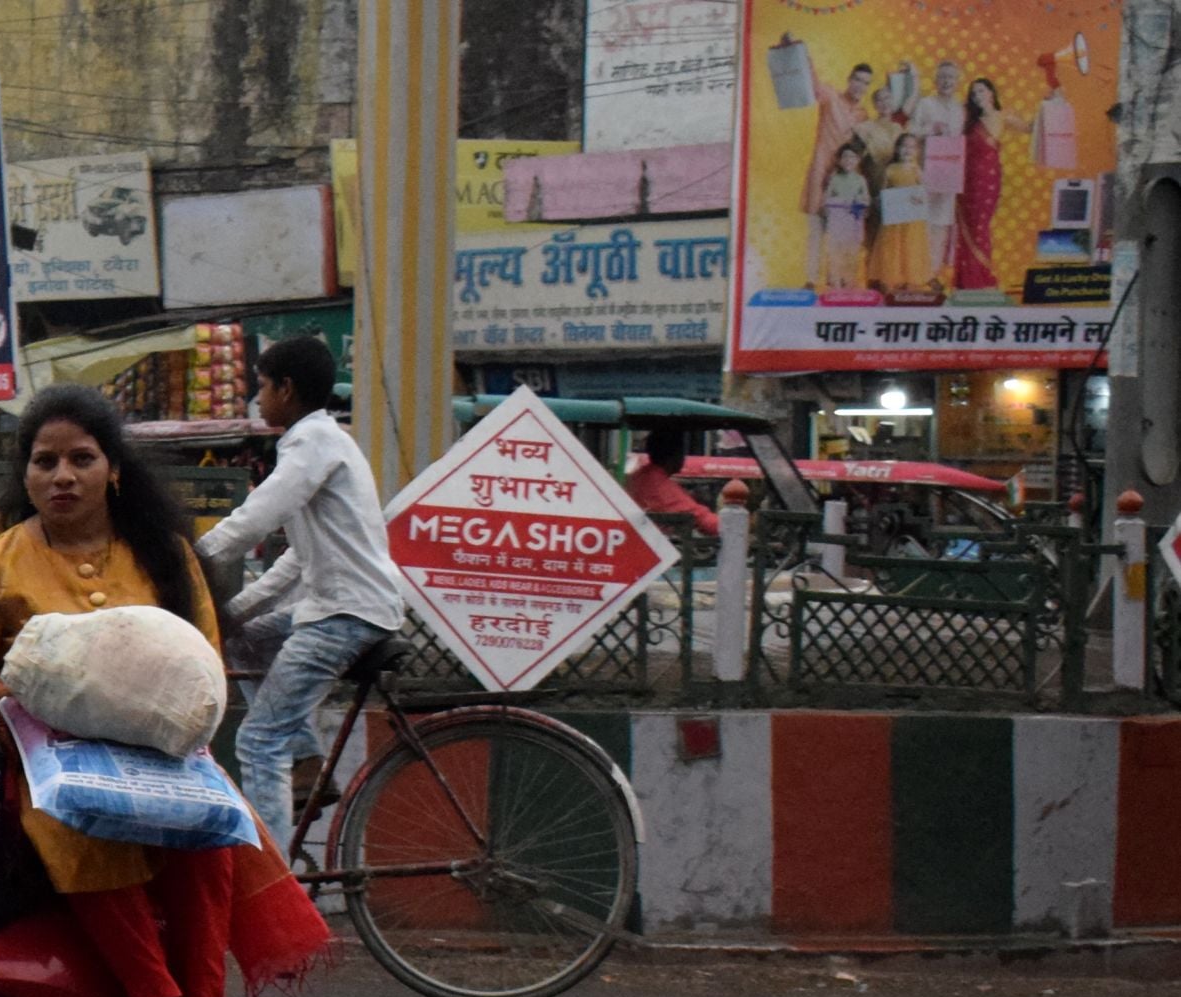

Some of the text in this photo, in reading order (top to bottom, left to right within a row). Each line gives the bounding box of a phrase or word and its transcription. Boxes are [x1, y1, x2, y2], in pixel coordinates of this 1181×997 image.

[875, 321, 919, 343] नाग
[985, 315, 1007, 343] के
[1013, 315, 1076, 343] सामने
[496, 438, 553, 464] भव्य
[843, 462, 892, 479] Yatri
[469, 473, 578, 507] शुभारंभ
[409, 515, 626, 556] MEGA SHOP
[496, 549, 508, 567] में
[469, 612, 553, 639] हरदोई
